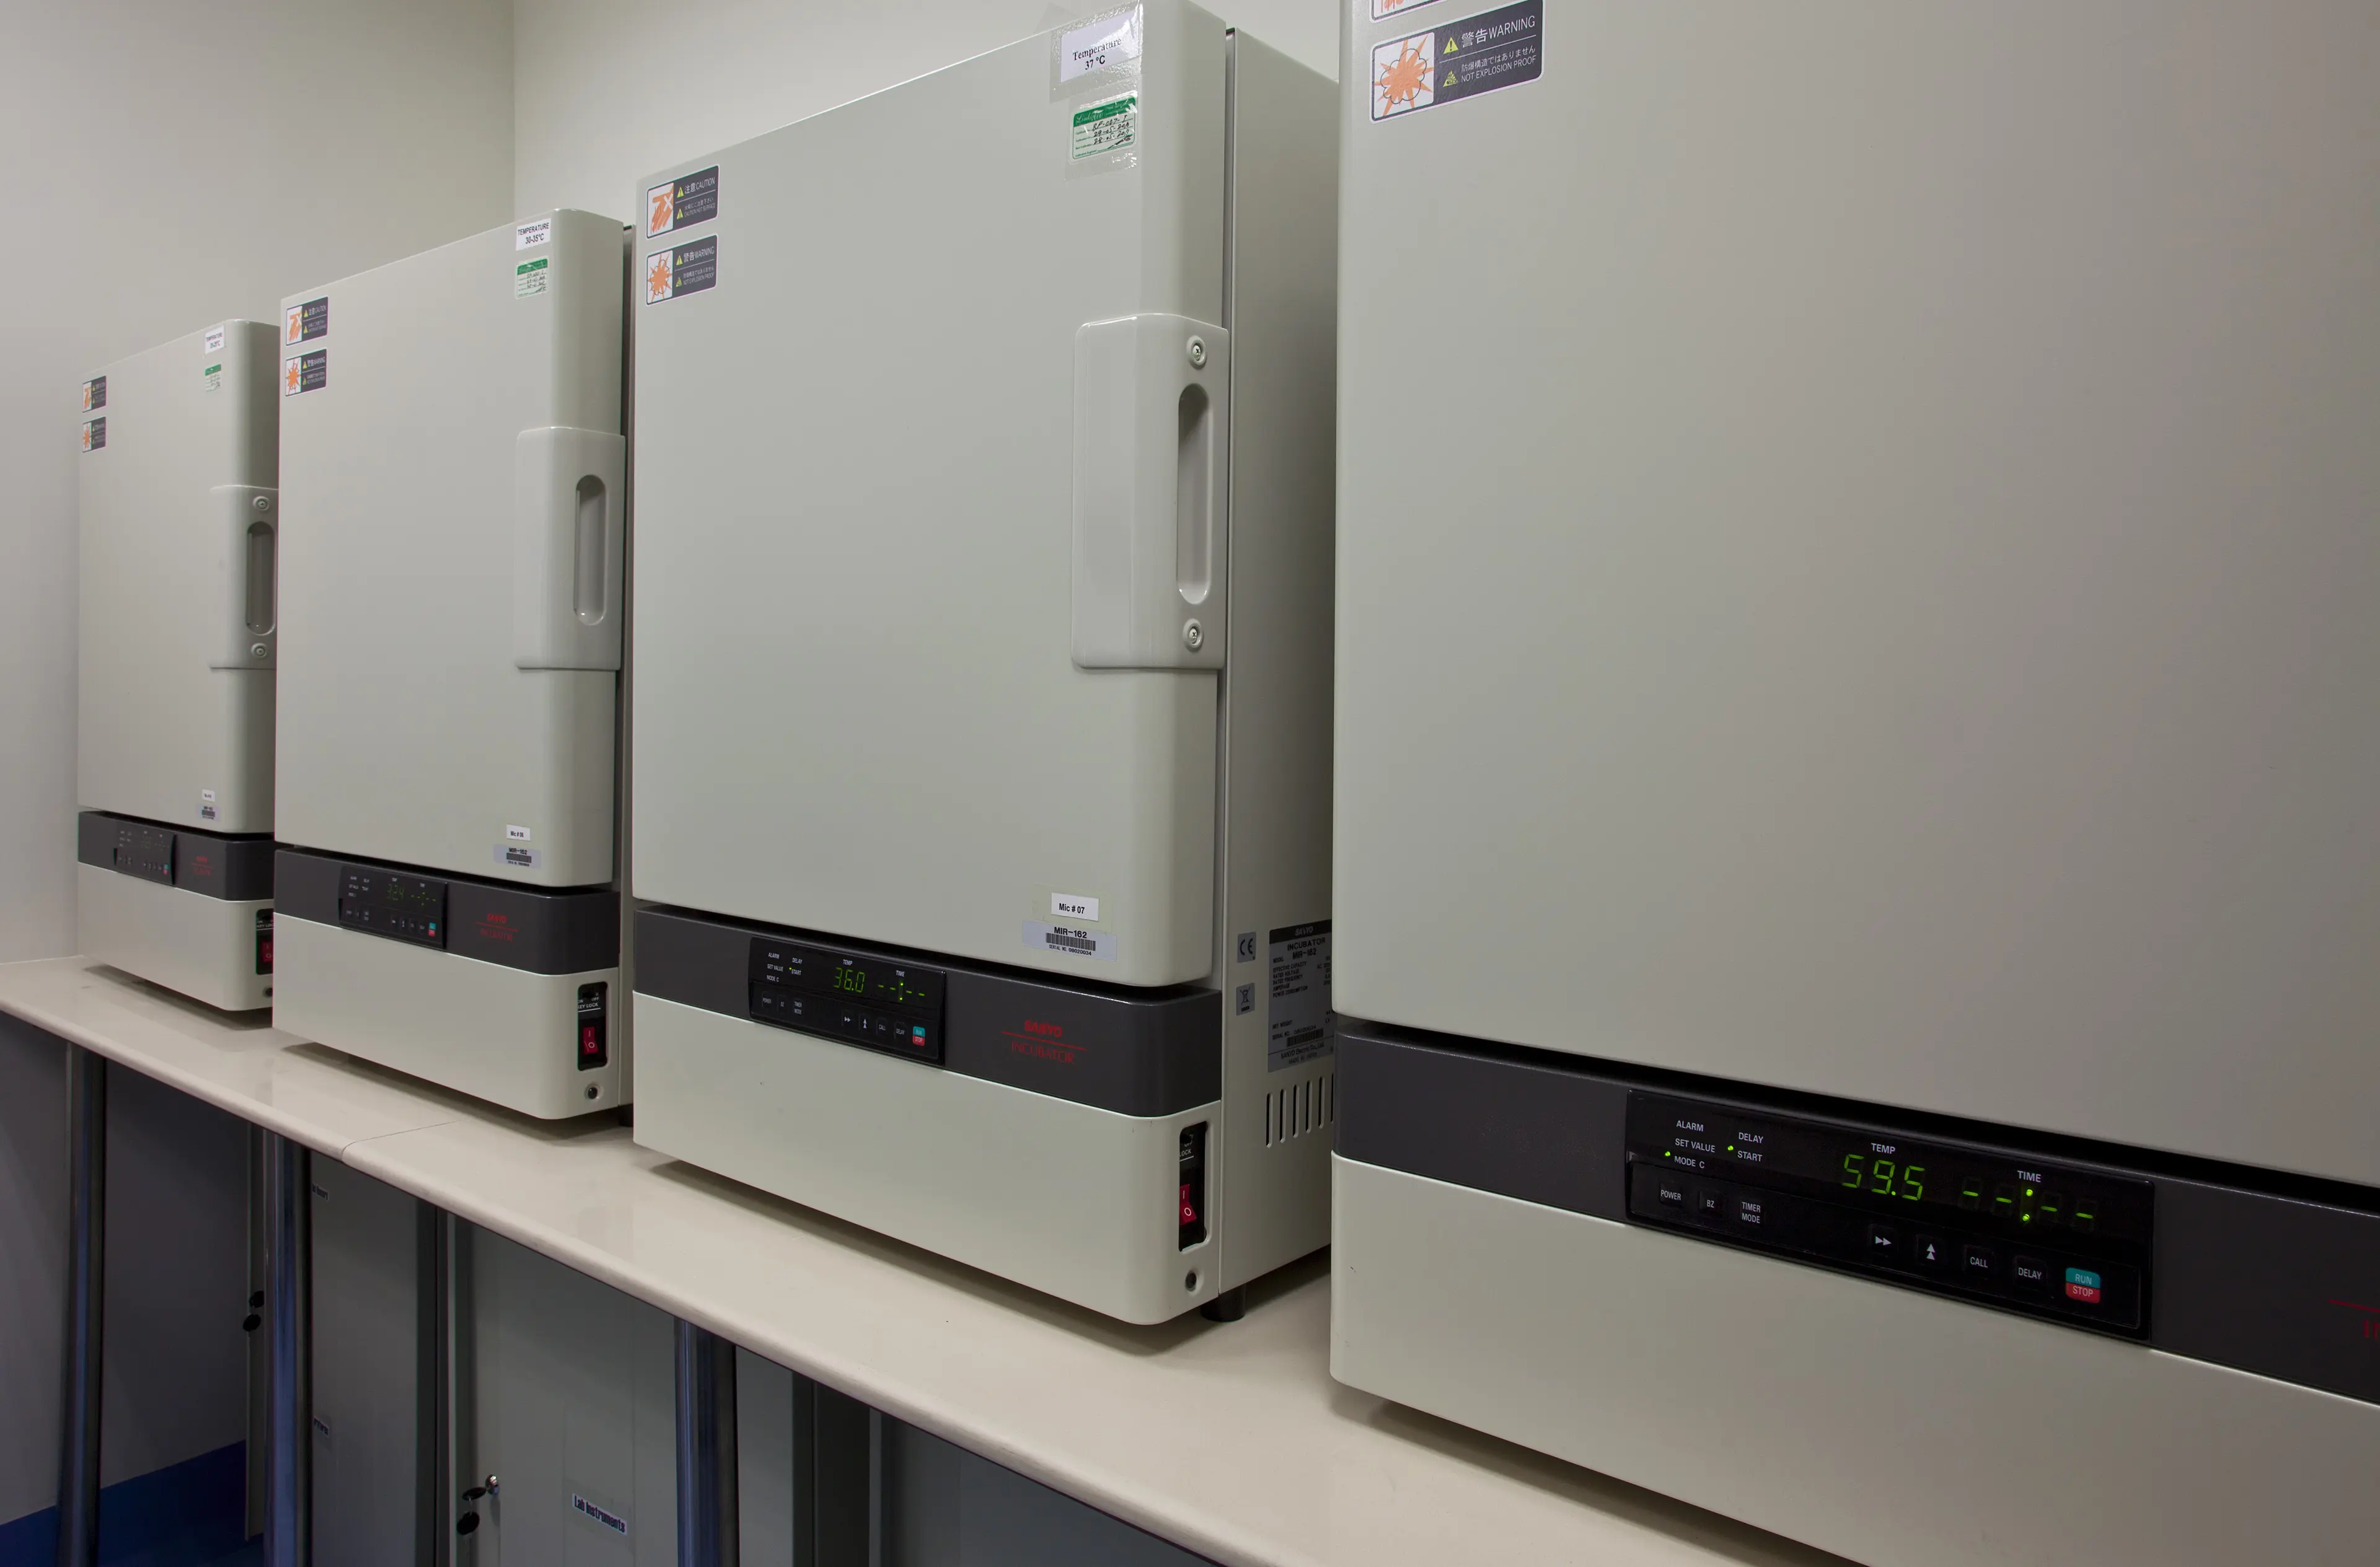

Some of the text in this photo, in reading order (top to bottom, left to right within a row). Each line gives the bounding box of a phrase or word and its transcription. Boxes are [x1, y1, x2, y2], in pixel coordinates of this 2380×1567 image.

[1461, 15, 1535, 48] 警告 WARNING
[1072, 38, 1122, 61] Temperature
[1085, 55, 1106, 71] 37 °C
[1461, 54, 1536, 83] NOT EXPLOSION PROOF
[695, 177, 715, 190] CAUTION
[518, 222, 549, 235] TEMPERATURE
[695, 246, 715, 259] WARNING
[509, 847, 527, 855] MIR-162
[1059, 903, 1070, 912] Mic
[1077, 906, 1085, 914] 07
[487, 912, 508, 924] SANYO
[1054, 926, 1088, 939] MIR-162
[1287, 937, 1326, 951] INCUBATOR
[1292, 948, 1316, 960] MIR-162
[833, 967, 865, 993] 36.0
[1024, 1019, 1063, 1037] SANYO
[1011, 1040, 1075, 1065] INCUBATOR
[1676, 1120, 1704, 1132] ALARM
[1739, 1132, 1764, 1144] DELAY
[1675, 1138, 1716, 1153] SET VALUE
[1871, 1143, 1895, 1154] TEMP
[1179, 1149, 1191, 1157] OCK
[1737, 1150, 1763, 1162] START
[1674, 1156, 1705, 1169] MODE C
[1841, 1153, 1926, 1201] 59.5
[2017, 1170, 2042, 1183] TIME
[1660, 1189, 1681, 1201] POWER
[1706, 1199, 1715, 1208] BZ
[1742, 1201, 1761, 1213] TIMER
[1742, 1213, 1761, 1224] MODE
[1970, 1257, 1988, 1268] CALL
[2018, 1267, 2042, 1279] DELAY
[2074, 1273, 2092, 1285] RUN
[2072, 1285, 2094, 1297] STOP
[575, 1495, 625, 1533] Lab Instruments
